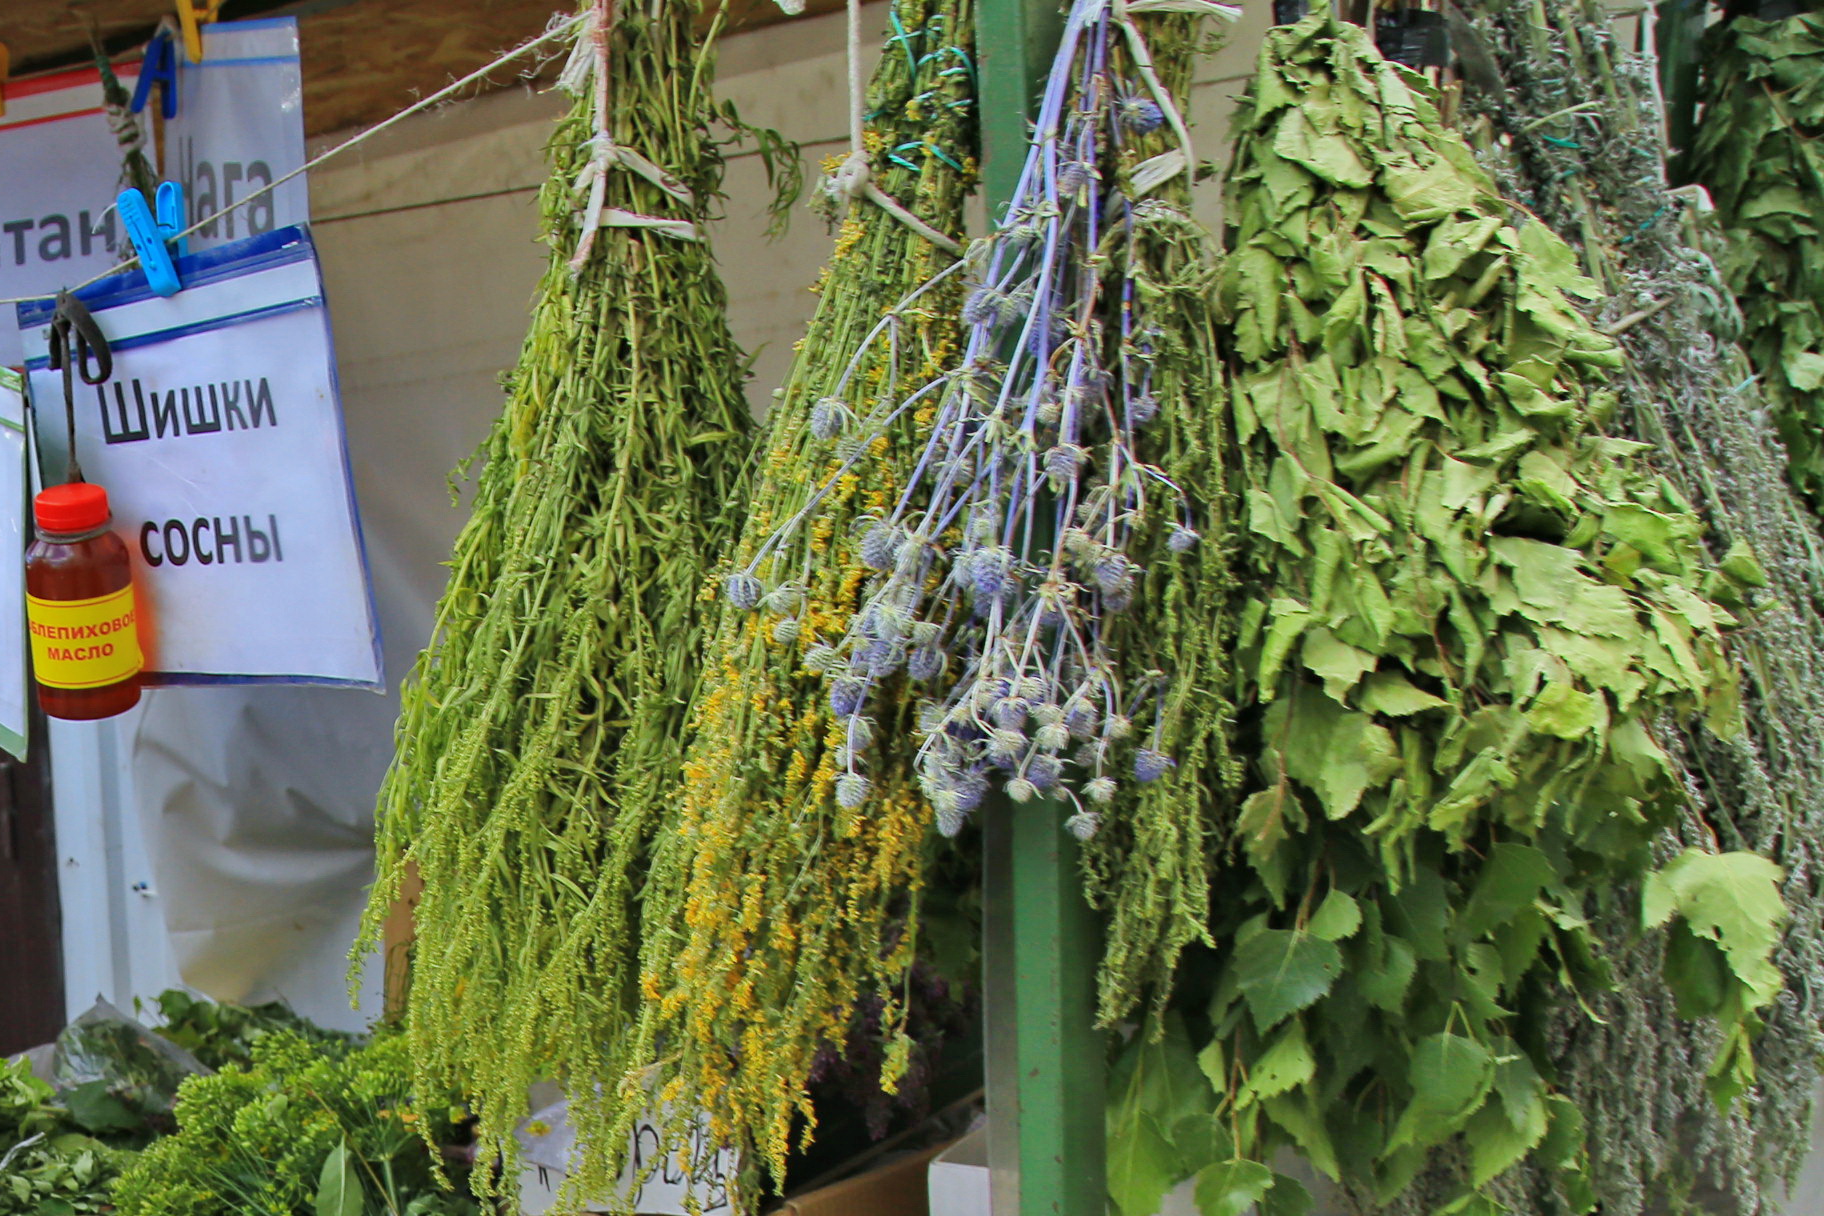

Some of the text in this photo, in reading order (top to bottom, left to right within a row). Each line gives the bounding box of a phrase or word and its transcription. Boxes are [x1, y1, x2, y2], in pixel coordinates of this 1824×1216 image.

[97, 376, 277, 445] Шишки
[139, 512, 284, 568] сосны
[29, 608, 135, 640] БЛЕПИХОВОЕ
[47, 642, 114, 662] МАСЛО
